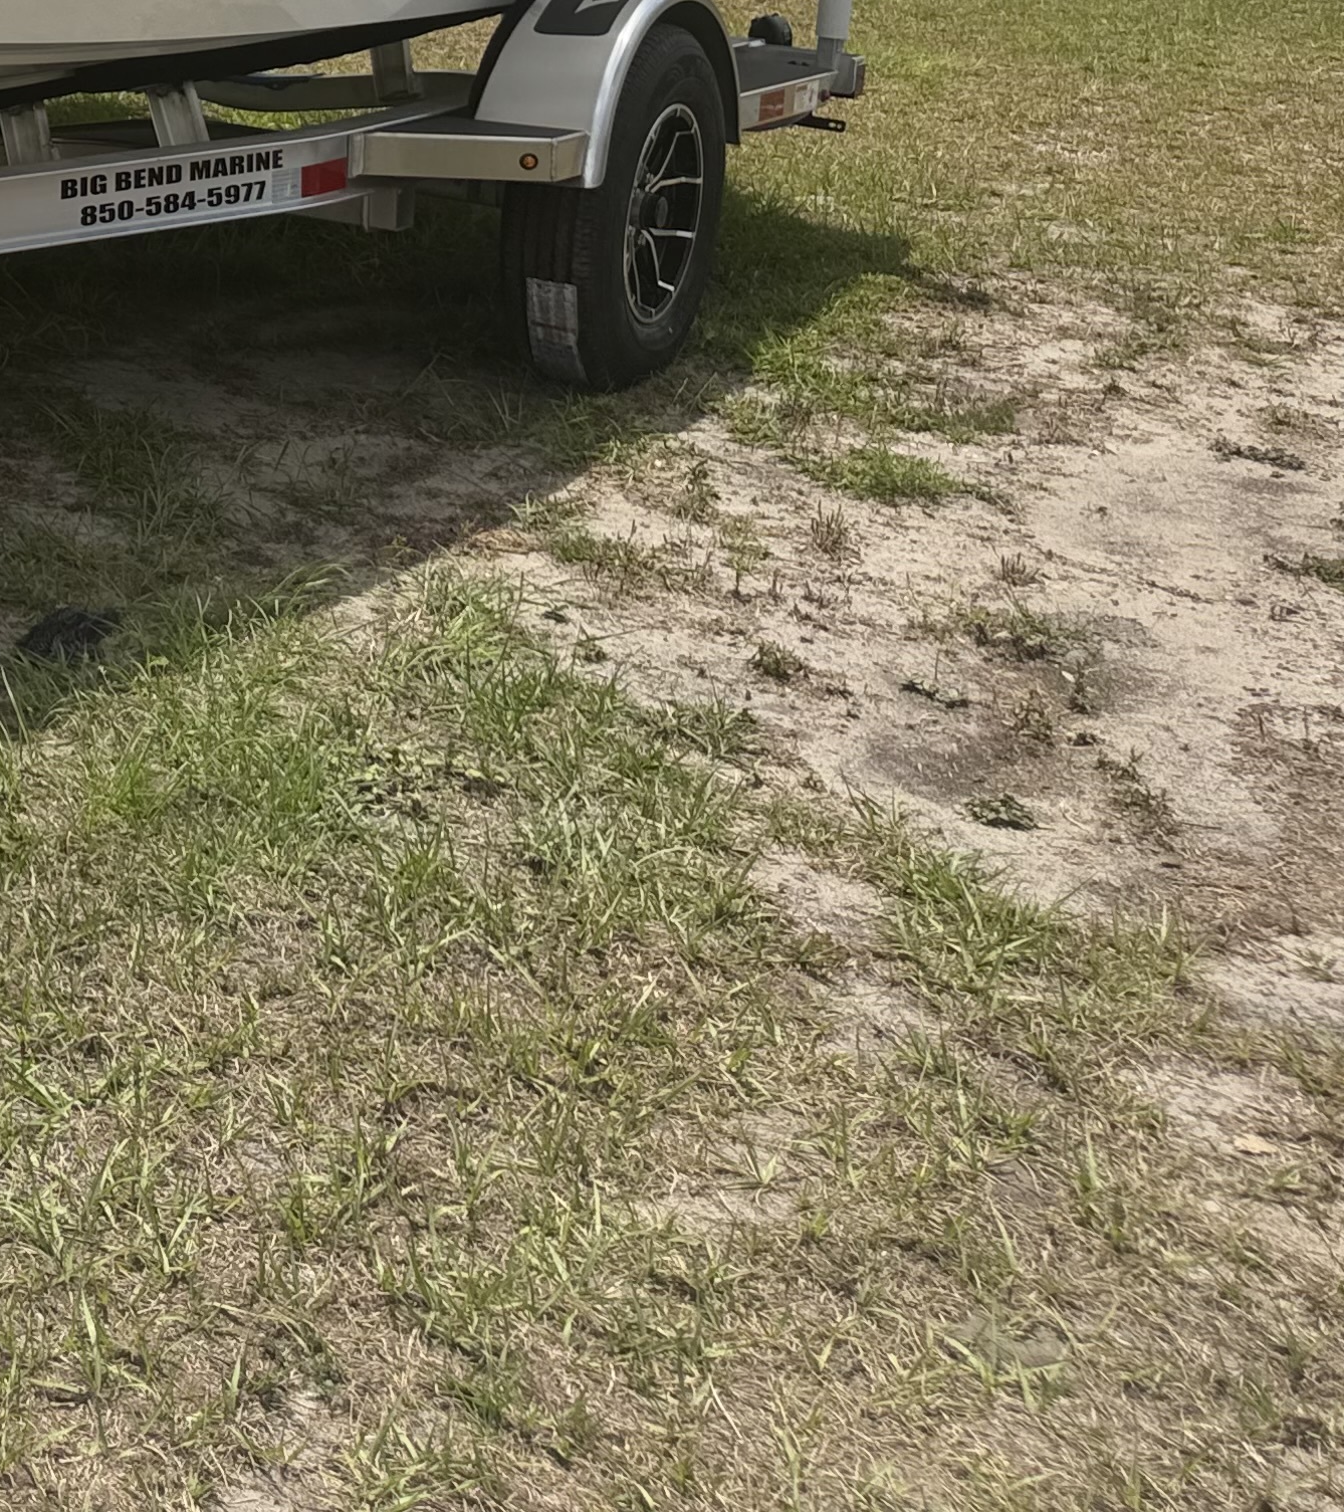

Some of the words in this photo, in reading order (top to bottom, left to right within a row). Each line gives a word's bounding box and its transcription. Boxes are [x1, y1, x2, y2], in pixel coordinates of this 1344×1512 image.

[60, 175, 108, 200] BIG
[114, 163, 183, 193] BEND
[189, 148, 284, 182] MARINE
[80, 180, 267, 226] 850-584-5977
